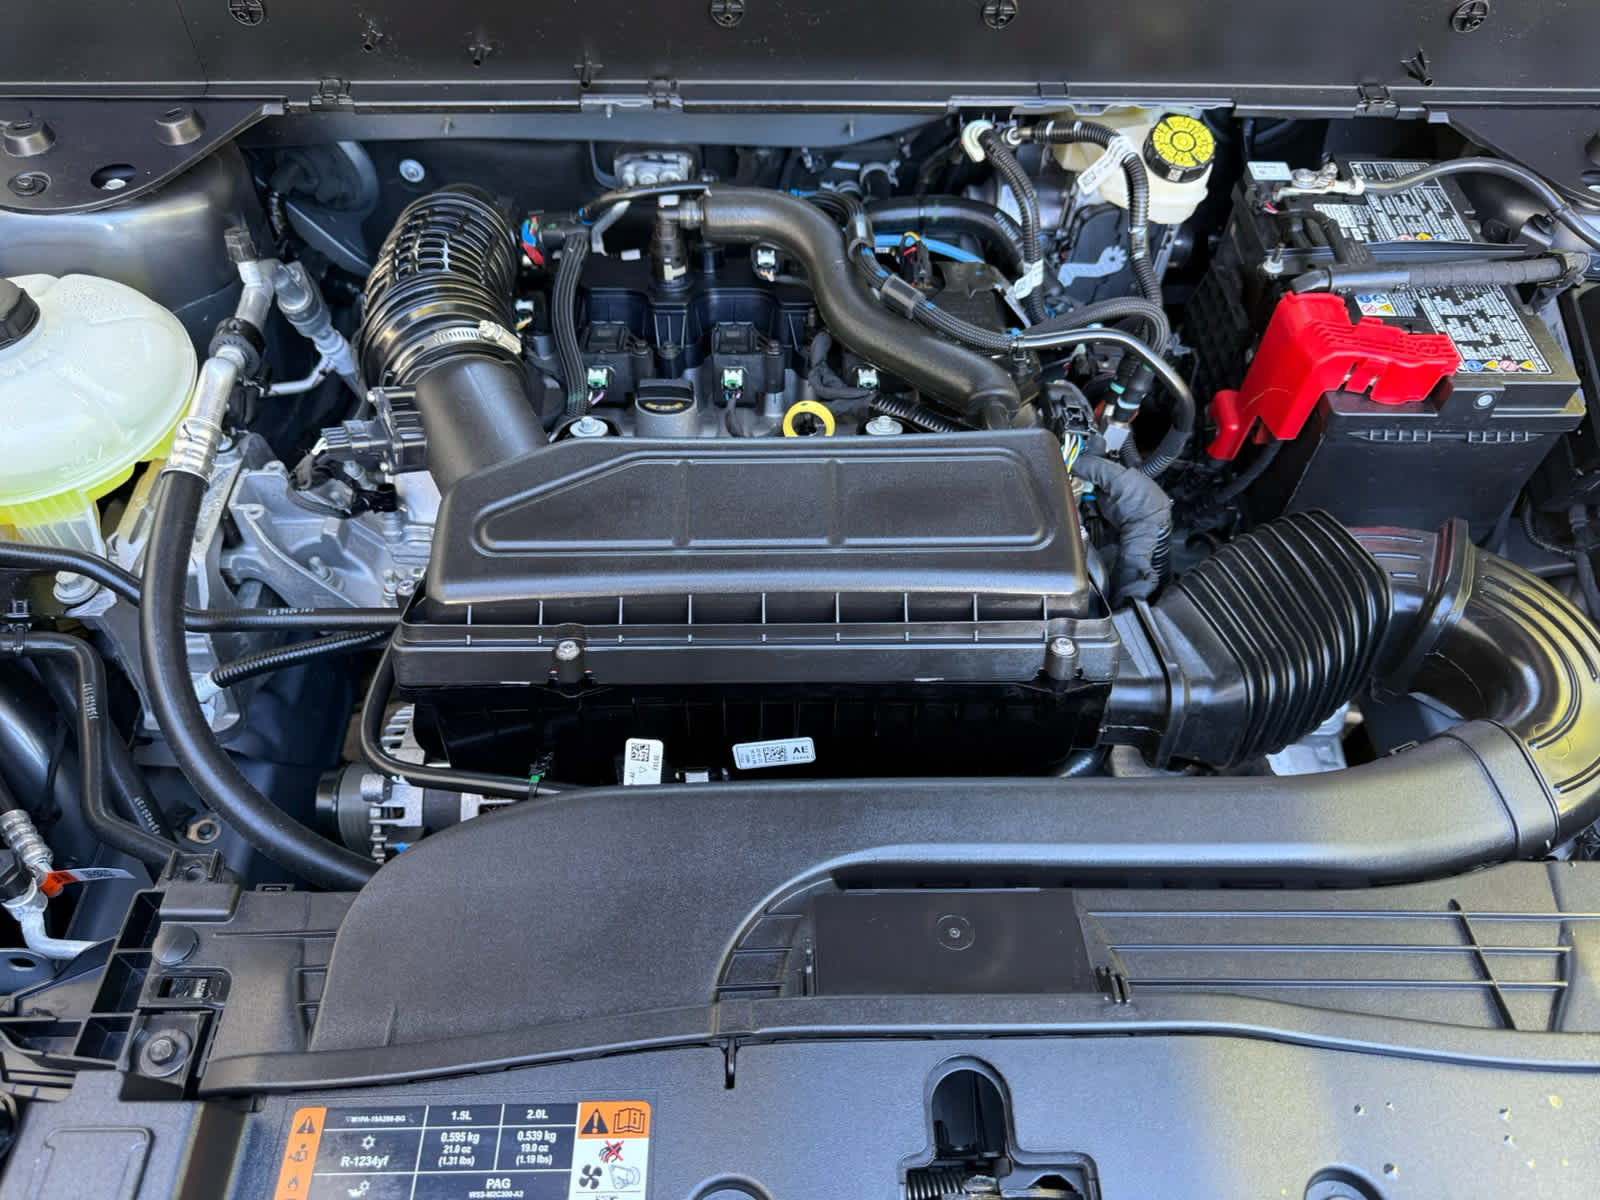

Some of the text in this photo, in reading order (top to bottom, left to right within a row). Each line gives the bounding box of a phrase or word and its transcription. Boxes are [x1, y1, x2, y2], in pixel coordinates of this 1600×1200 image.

[451, 1110, 472, 1121] 1.5L
[526, 1109, 549, 1119] 2.0L
[441, 1132, 480, 1144] 0.595 kg
[517, 1131, 557, 1144] 0.539 kg
[443, 1145, 472, 1154] 21.0 oz
[538, 1145, 549, 1153] oz
[340, 1155, 390, 1169] R-1234yf
[459, 1156, 475, 1167] lbs)
[537, 1154, 553, 1166] lbs)
[486, 1178, 511, 1190] PAG
